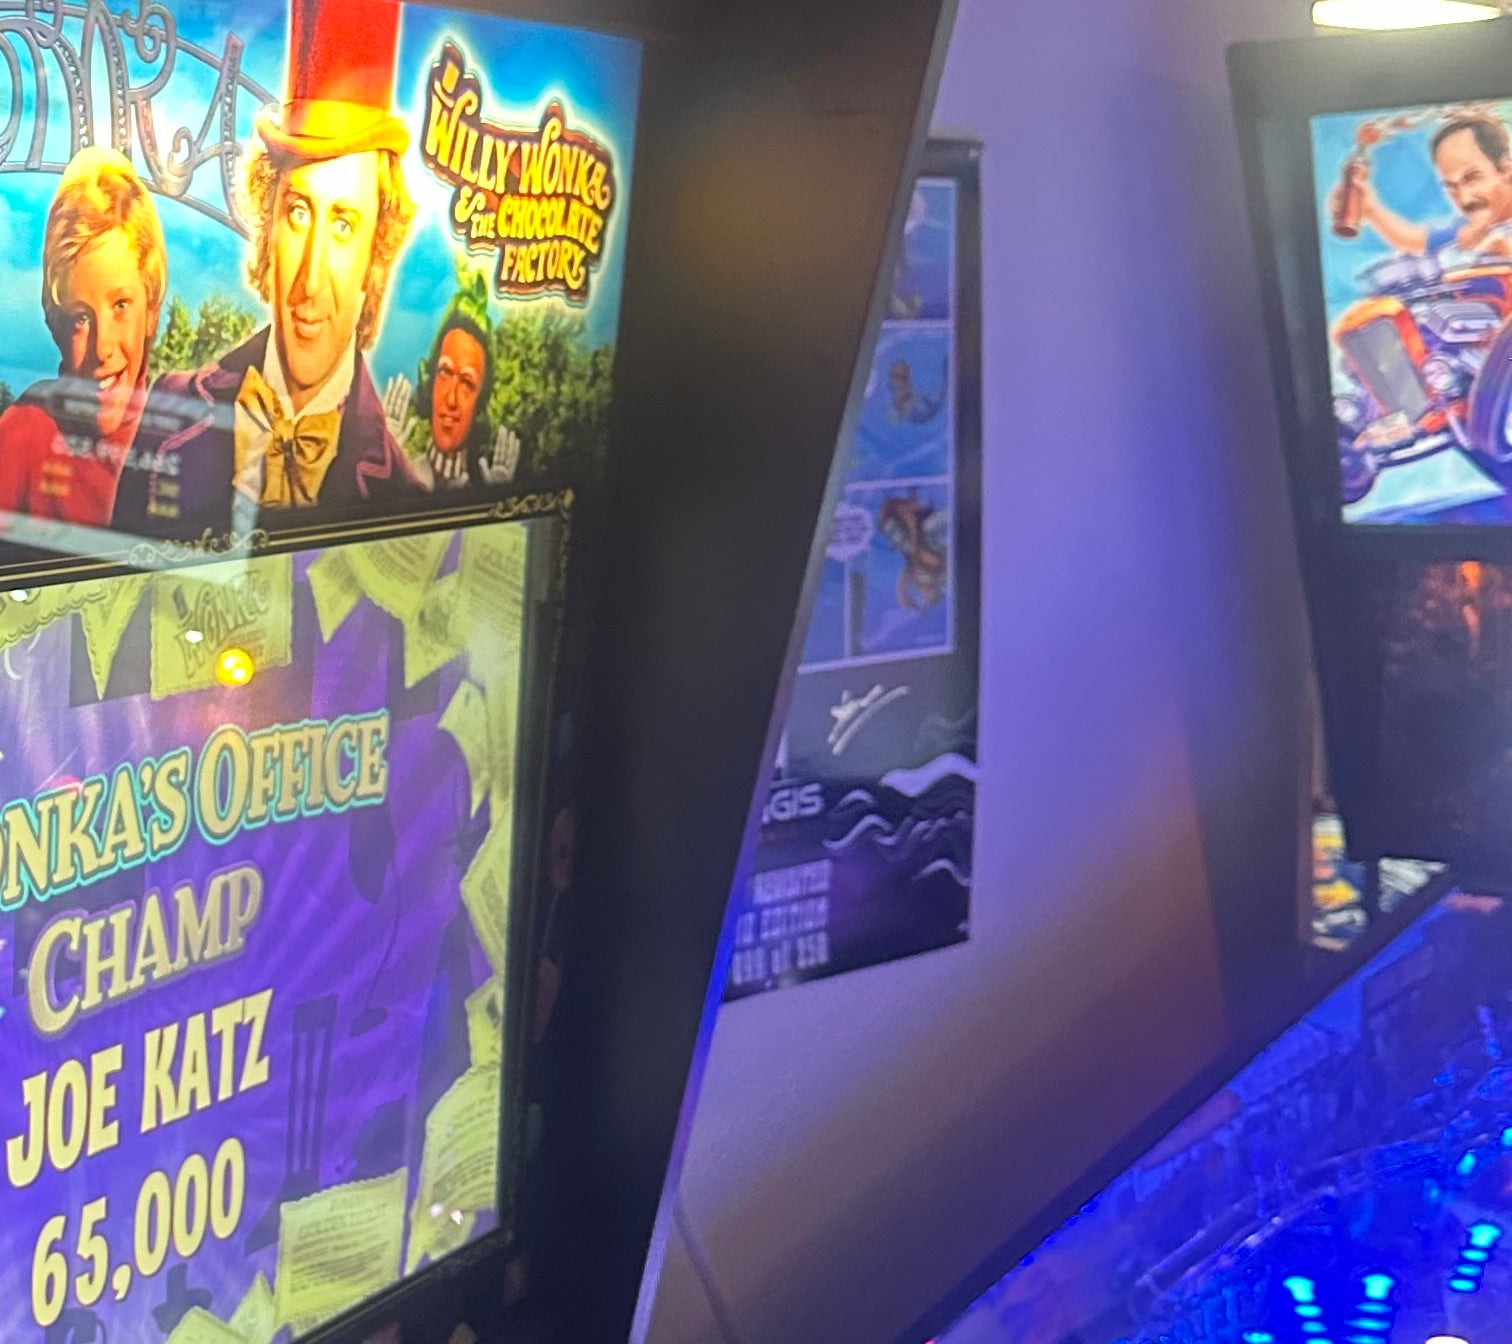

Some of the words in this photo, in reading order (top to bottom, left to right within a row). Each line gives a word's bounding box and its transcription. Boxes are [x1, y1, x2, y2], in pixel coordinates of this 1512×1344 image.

[425, 88, 517, 195] WILLY
[520, 116, 611, 210] WONKA
[471, 213, 496, 238] THE
[497, 192, 603, 255] CHOCOLATE
[501, 239, 587, 290] FACTORY
[194, 709, 389, 843] OFFICE
[27, 864, 264, 1038] CHAMP
[5, 1044, 123, 1188] JOE
[141, 989, 273, 1133] KATZ
[31, 1137, 245, 1328] 65,000
